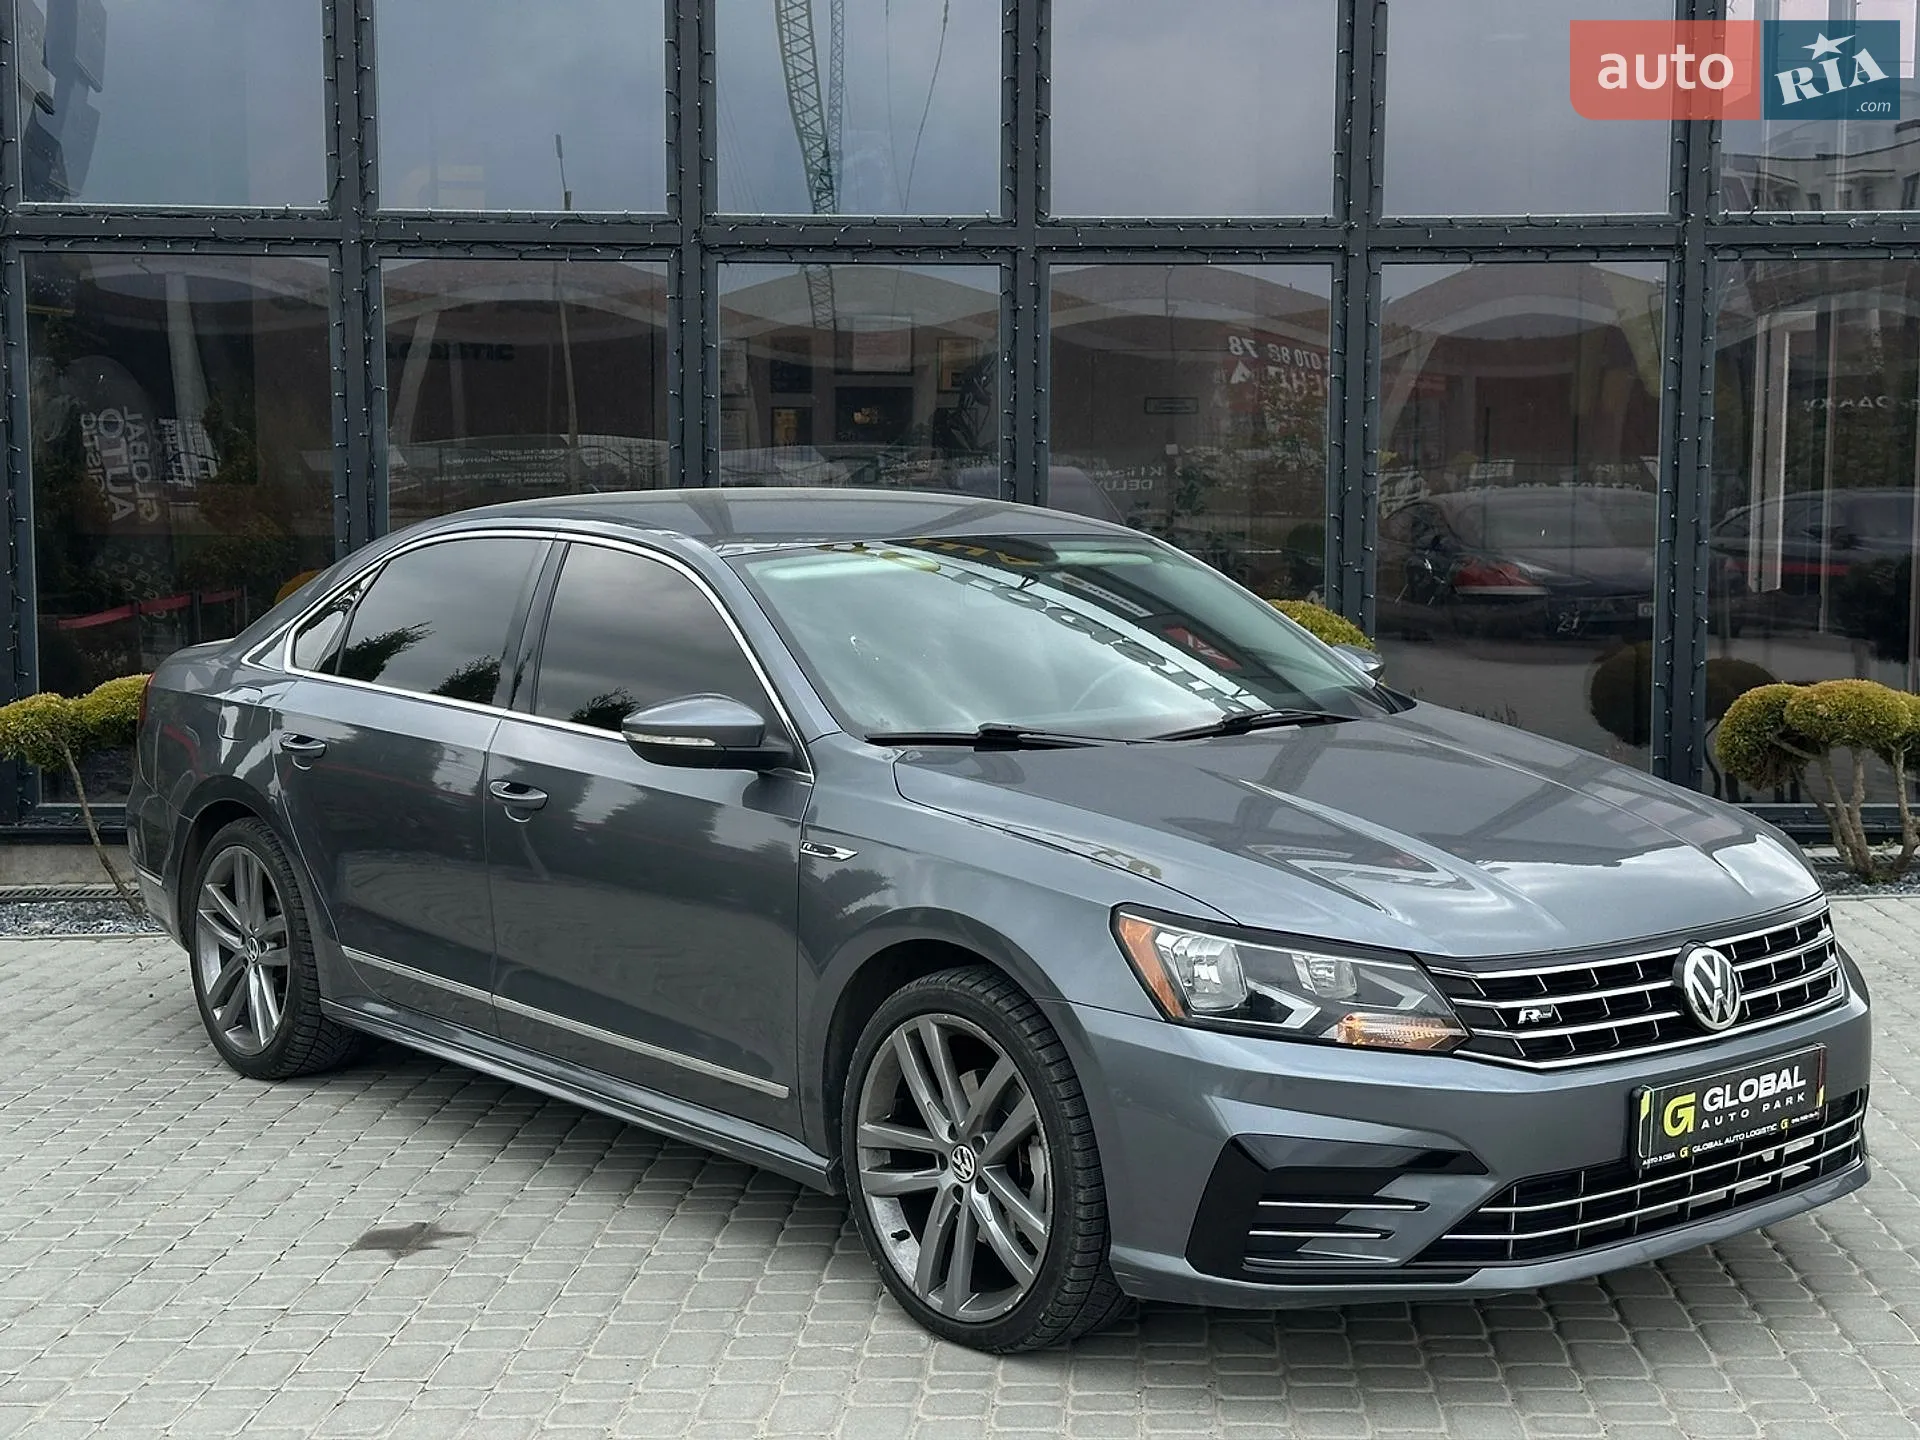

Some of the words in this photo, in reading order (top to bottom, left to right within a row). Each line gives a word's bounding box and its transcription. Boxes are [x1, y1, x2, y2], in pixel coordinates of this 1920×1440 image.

[1702, 1065, 1807, 1112] GLOBAL
[1701, 1109, 1750, 1130] AUTO
[1762, 1091, 1806, 1113] PARK
[1692, 1138, 1724, 1154] GLOBAL
[1724, 1132, 1745, 1146] AUTO
